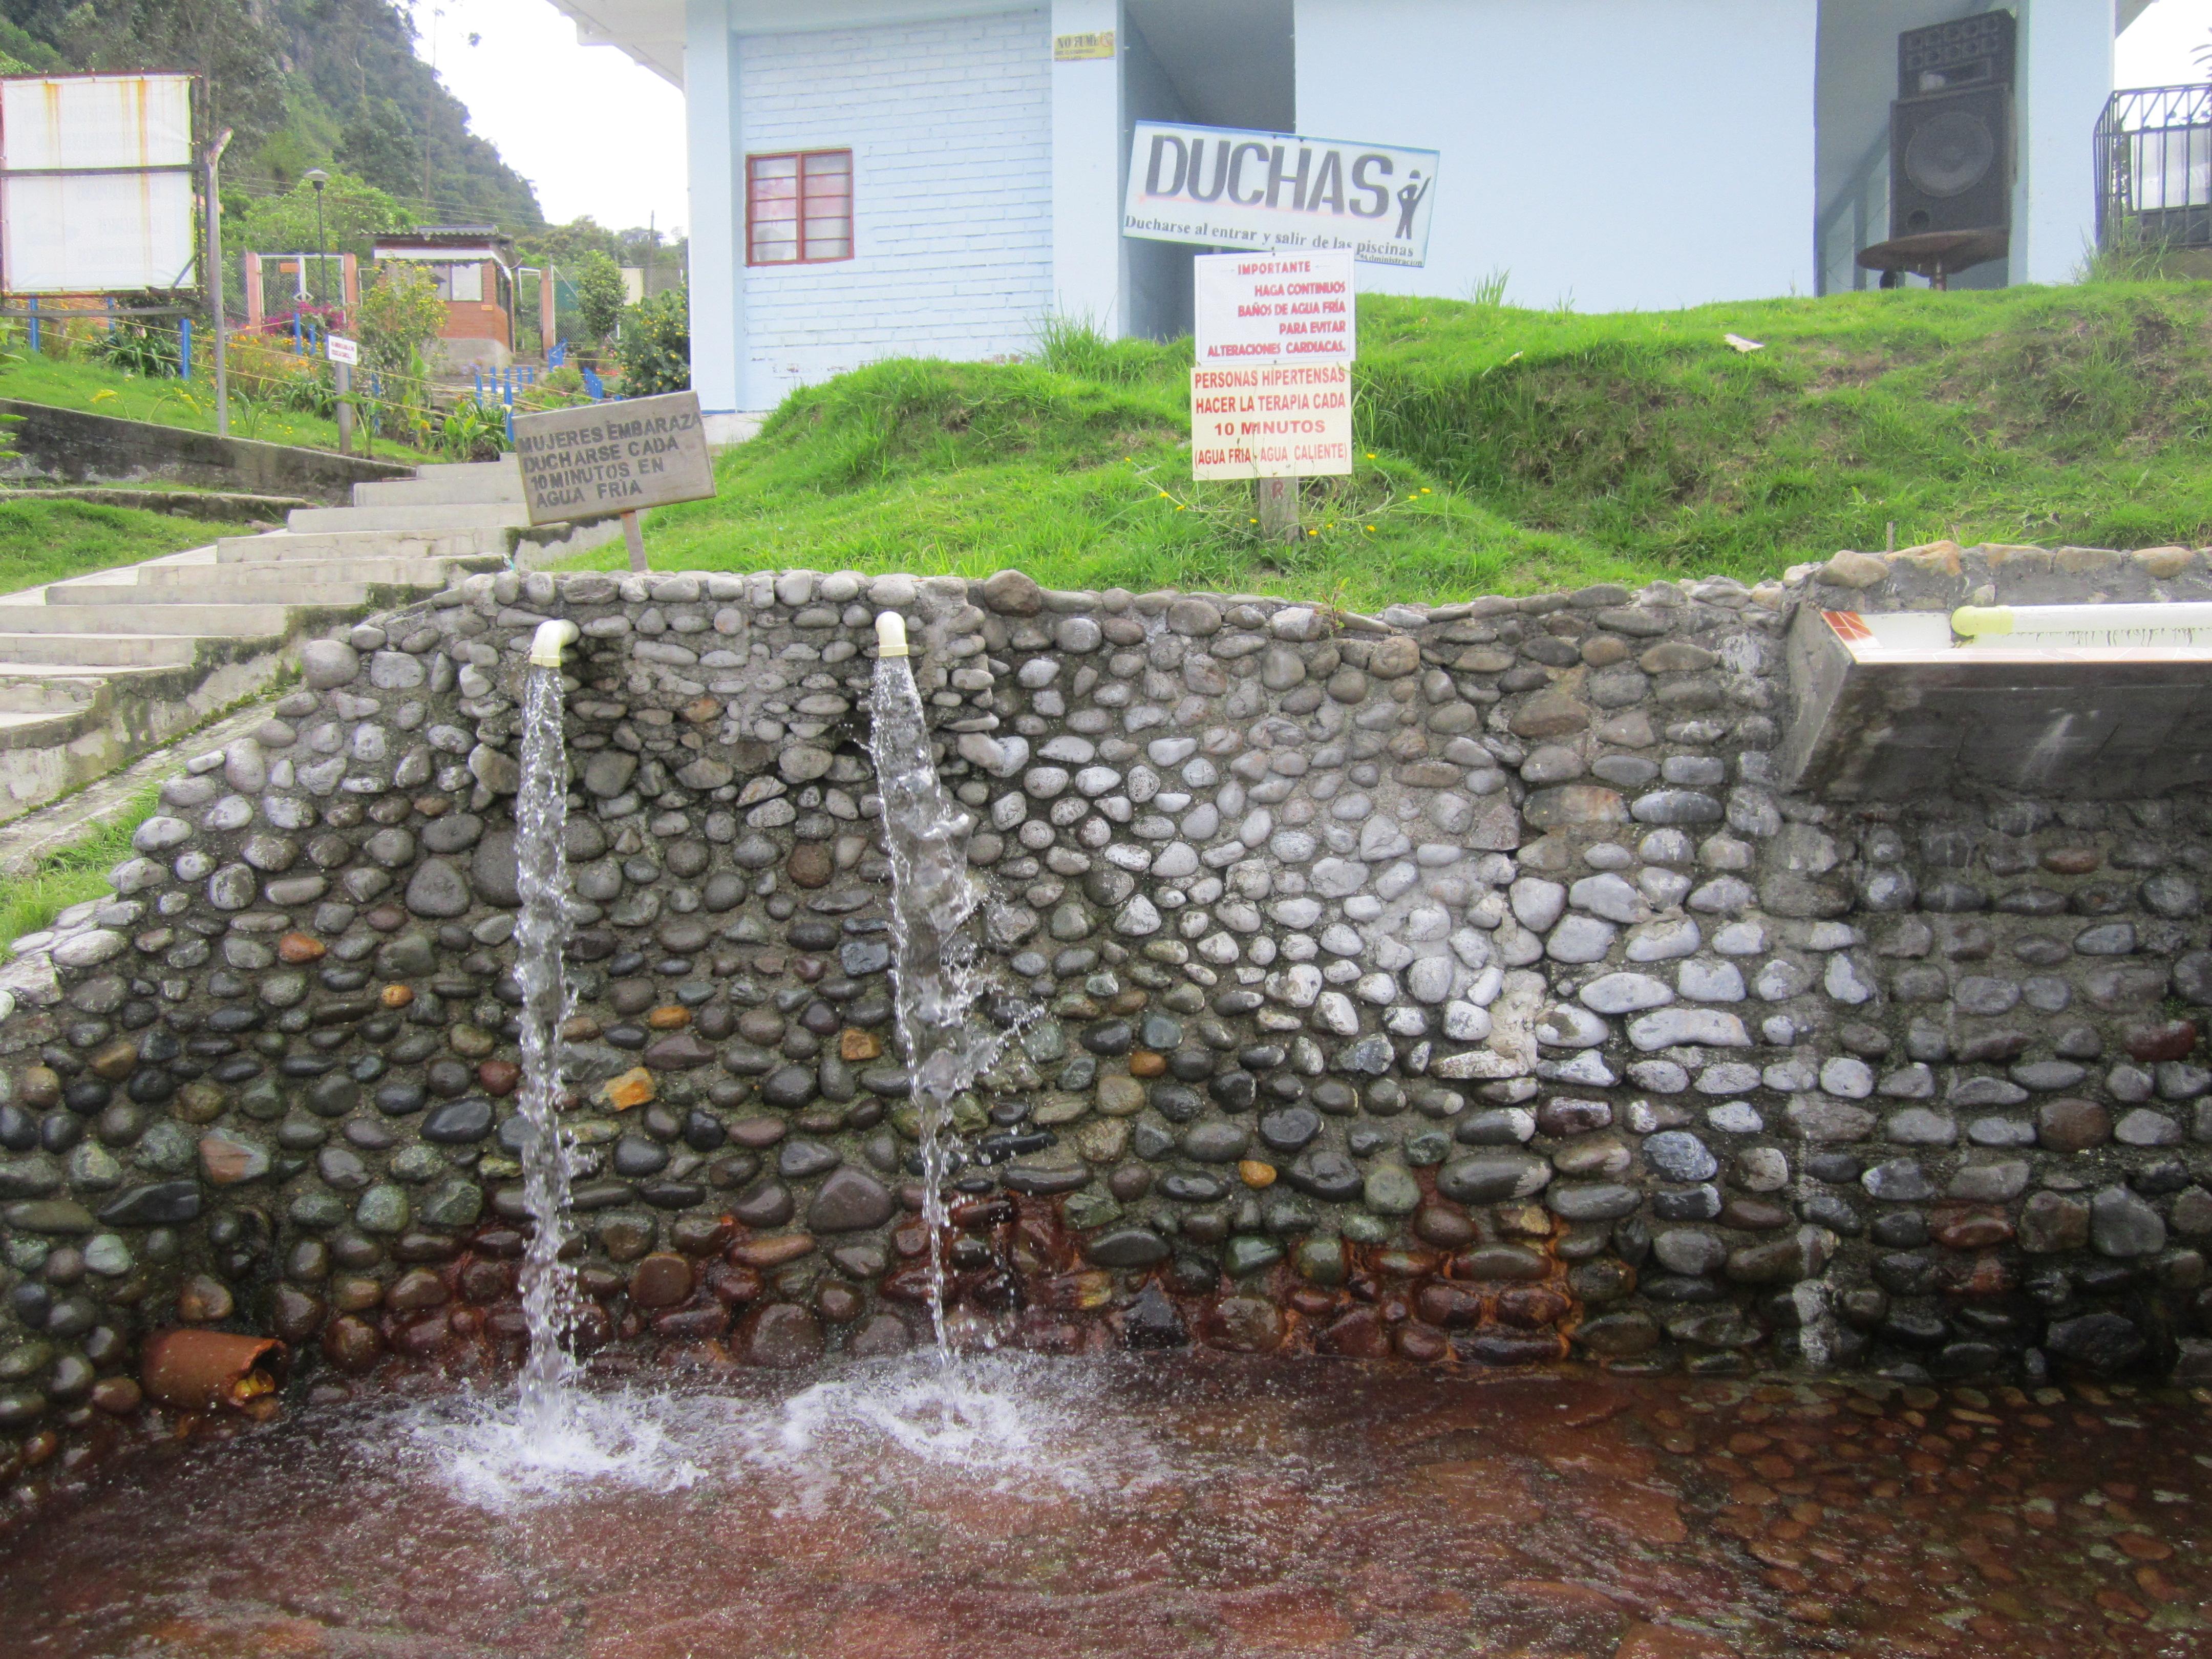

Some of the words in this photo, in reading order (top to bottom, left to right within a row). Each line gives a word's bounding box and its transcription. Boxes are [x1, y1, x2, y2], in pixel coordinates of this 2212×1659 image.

[1145, 134, 1393, 218] DUCHAS
[1125, 215, 1190, 234] Ducharse
[1195, 222, 1208, 236] al
[1212, 226, 1257, 241] entrar
[1262, 233, 1271, 245] y
[1275, 231, 1307, 246] salir
[1312, 236, 1329, 249] de
[1333, 237, 1352, 249] las
[1357, 240, 1414, 257] piscinas
[1238, 261, 1311, 275] IMPORTANTE
[1254, 283, 1285, 296] HAGA
[1287, 281, 1346, 295] CONTINUOS
[1238, 302, 1272, 317] BAÑOS
[1274, 303, 1288, 315] DE
[1291, 302, 1320, 314] AGUA
[1322, 297, 1346, 313] FRÍA
[1280, 321, 1308, 334] PARA
[1310, 320, 1346, 333] EVITAR
[1207, 343, 1281, 357] ALTERACIONES
[1286, 339, 1346, 354] CARDIACAS.
[1195, 370, 1258, 389] PERSONAS
[1262, 366, 1346, 386] HIPERTENSAS
[1196, 396, 1236, 414] HACER
[1240, 395, 1254, 411] LA
[1258, 393, 1309, 410] TERAPIA
[1313, 392, 1346, 409] CADA
[519, 426, 604, 454] MUJERES
[606, 411, 703, 440] EMBARAZA
[1214, 422, 1235, 436] 10
[1241, 419, 1326, 435] MINUTOS
[524, 443, 622, 474] DUCHARSE
[628, 435, 679, 457] CADA
[1195, 449, 1226, 469] (AGUA
[1228, 448, 1251, 464] FRIA
[1260, 446, 1288, 462] AGUA
[1294, 442, 1347, 461] CALIENTE)
[530, 474, 548, 492] 10
[548, 461, 630, 489] MINUTOS
[638, 457, 664, 475] EN
[536, 486, 585, 508] AGUA
